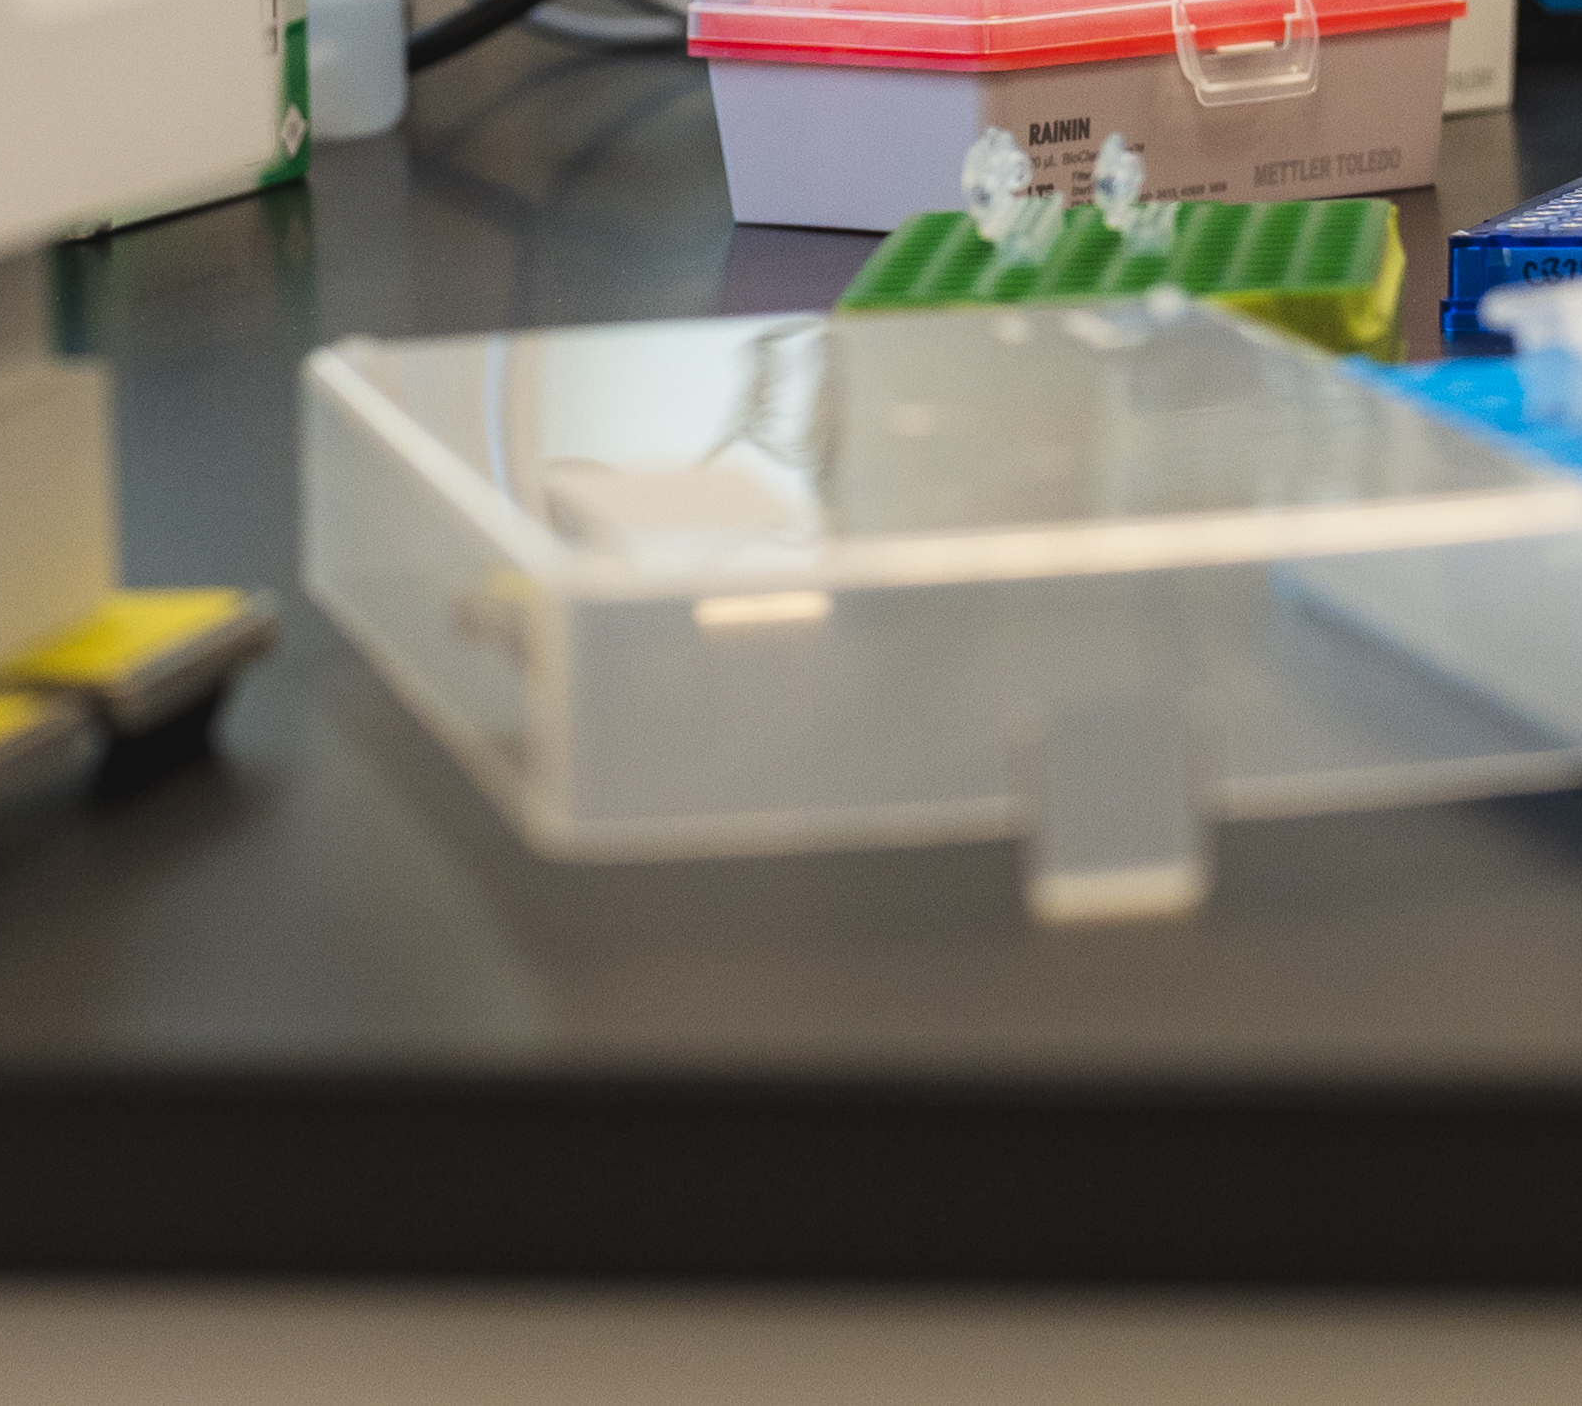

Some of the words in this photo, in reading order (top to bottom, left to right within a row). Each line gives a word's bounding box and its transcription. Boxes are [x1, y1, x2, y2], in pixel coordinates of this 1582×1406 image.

[1029, 117, 1091, 146] RAININ
[1254, 156, 1332, 188] METTLER
[1336, 146, 1403, 178] TOLEDO
